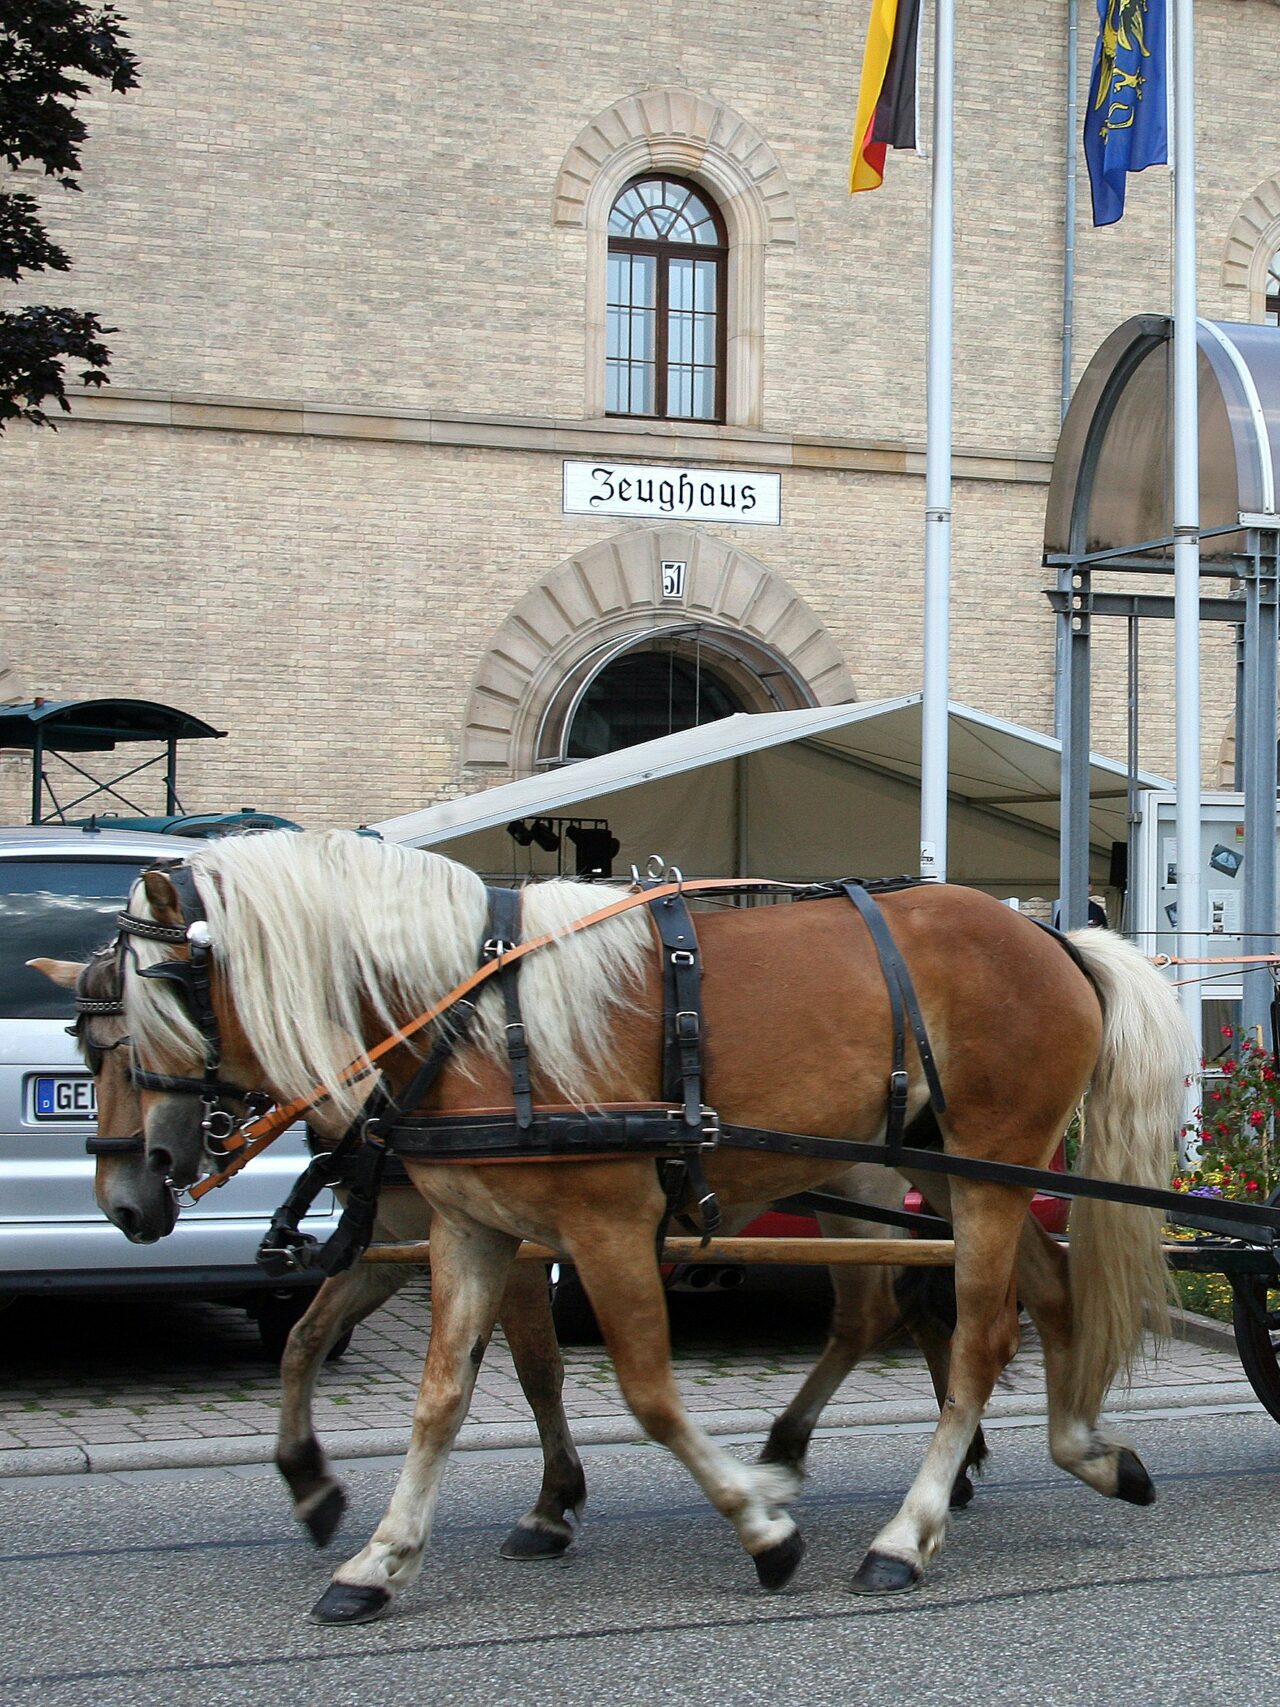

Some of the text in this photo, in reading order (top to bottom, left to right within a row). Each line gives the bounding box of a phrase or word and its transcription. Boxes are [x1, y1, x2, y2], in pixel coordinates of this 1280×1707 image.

[589, 467, 757, 515] Zeughaus
[664, 563, 682, 595] 51
[43, 1100, 50, 1108] D
